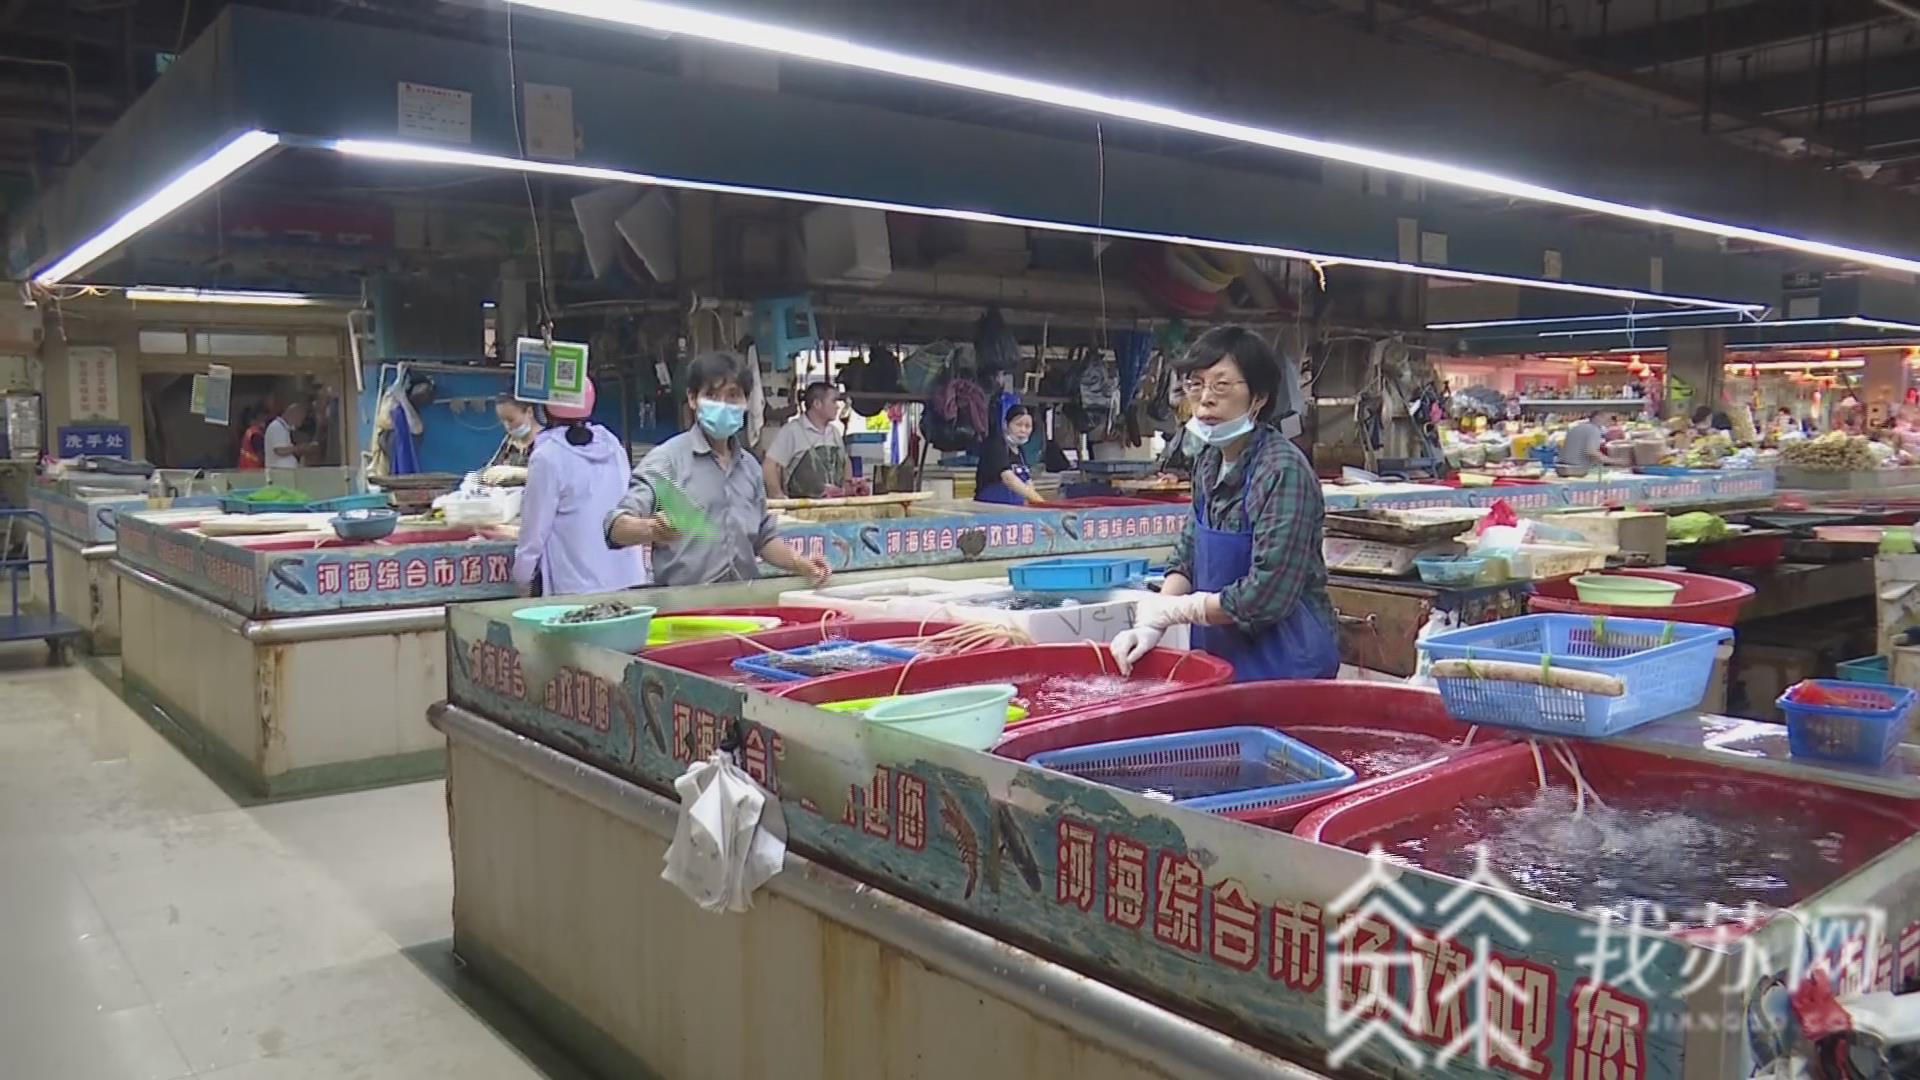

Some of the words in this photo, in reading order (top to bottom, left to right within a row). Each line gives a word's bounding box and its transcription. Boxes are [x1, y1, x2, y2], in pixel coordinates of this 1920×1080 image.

[65, 434, 123, 449] 洗手处
[886, 523, 1035, 556] 河海综合欢迎您
